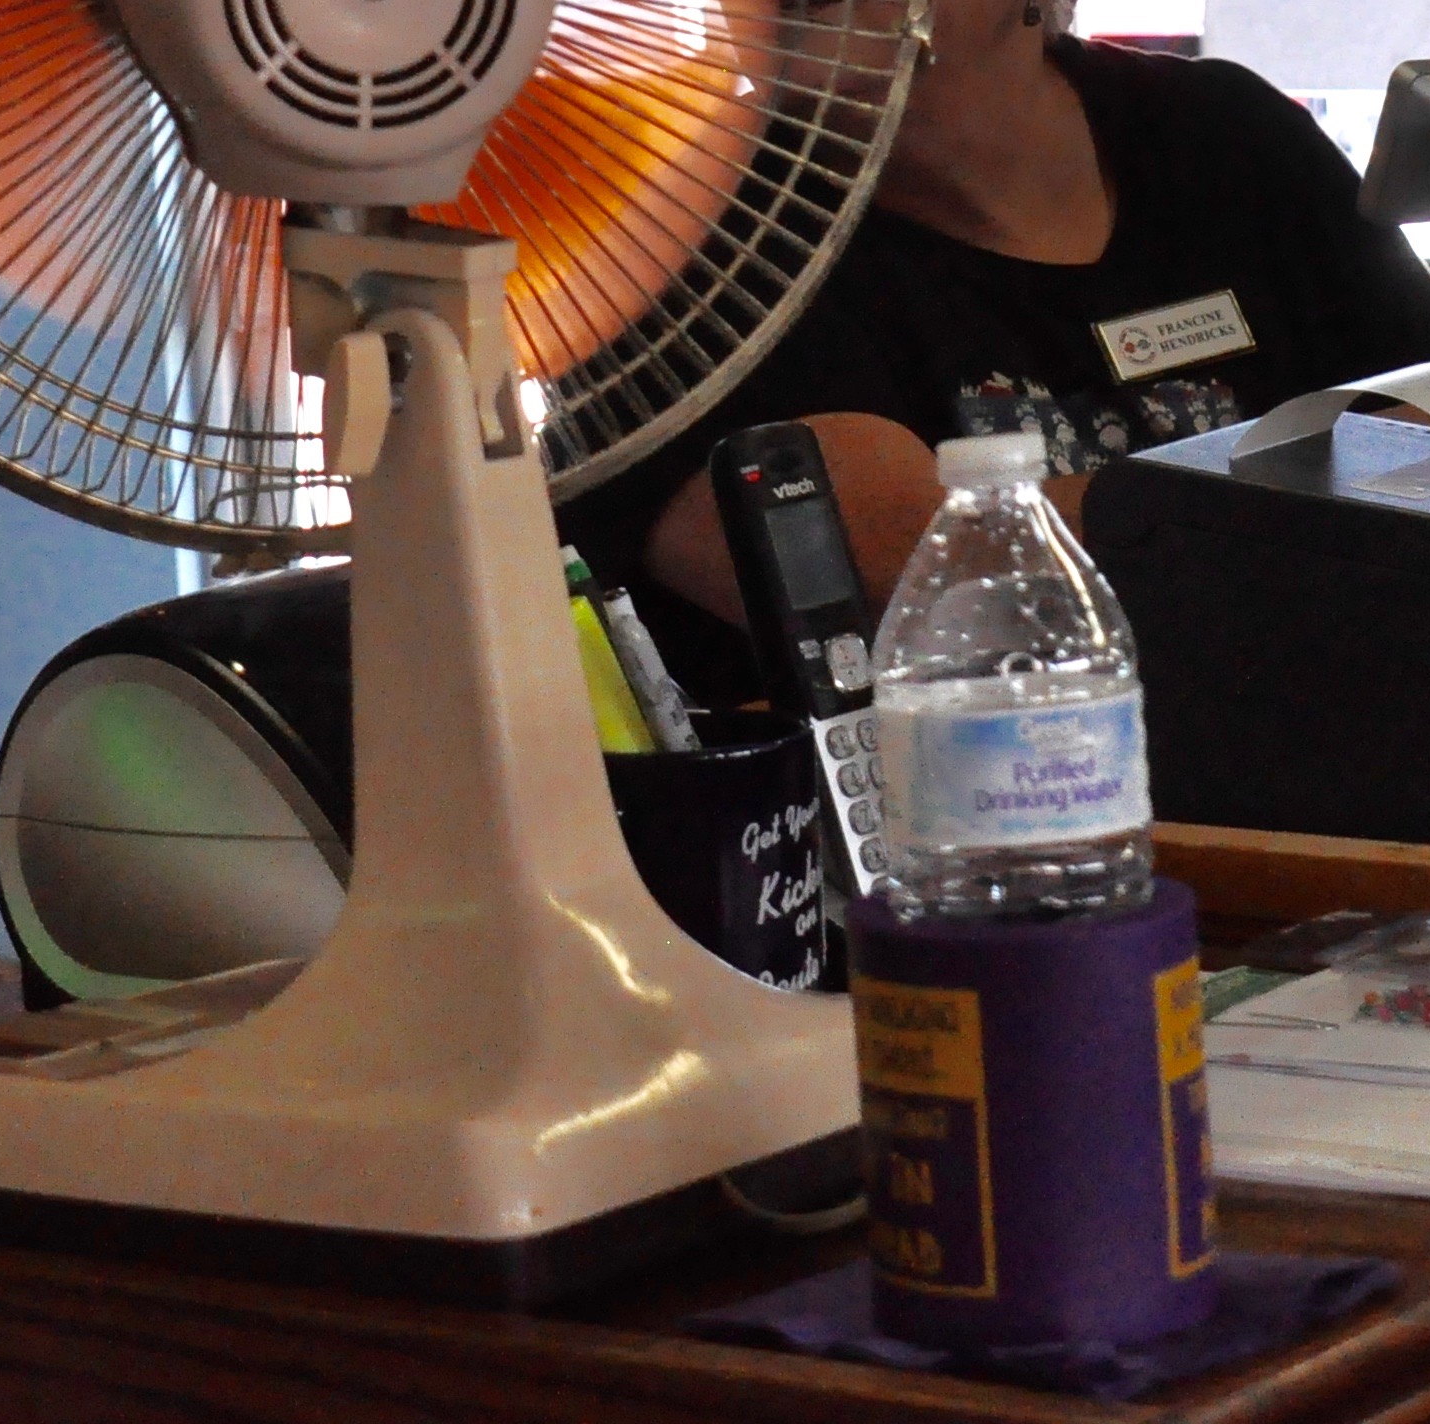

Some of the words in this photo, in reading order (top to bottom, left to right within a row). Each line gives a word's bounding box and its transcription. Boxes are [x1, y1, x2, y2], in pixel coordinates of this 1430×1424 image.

[1155, 308, 1226, 337] FRANCINE
[1157, 323, 1238, 354] HENDRICKS
[772, 476, 817, 499] vtech
[1012, 756, 1097, 786] Purified
[974, 787, 1069, 813] Drinking
[1072, 777, 1123, 803] Water
[741, 811, 782, 864] Get
[794, 905, 818, 938] on
